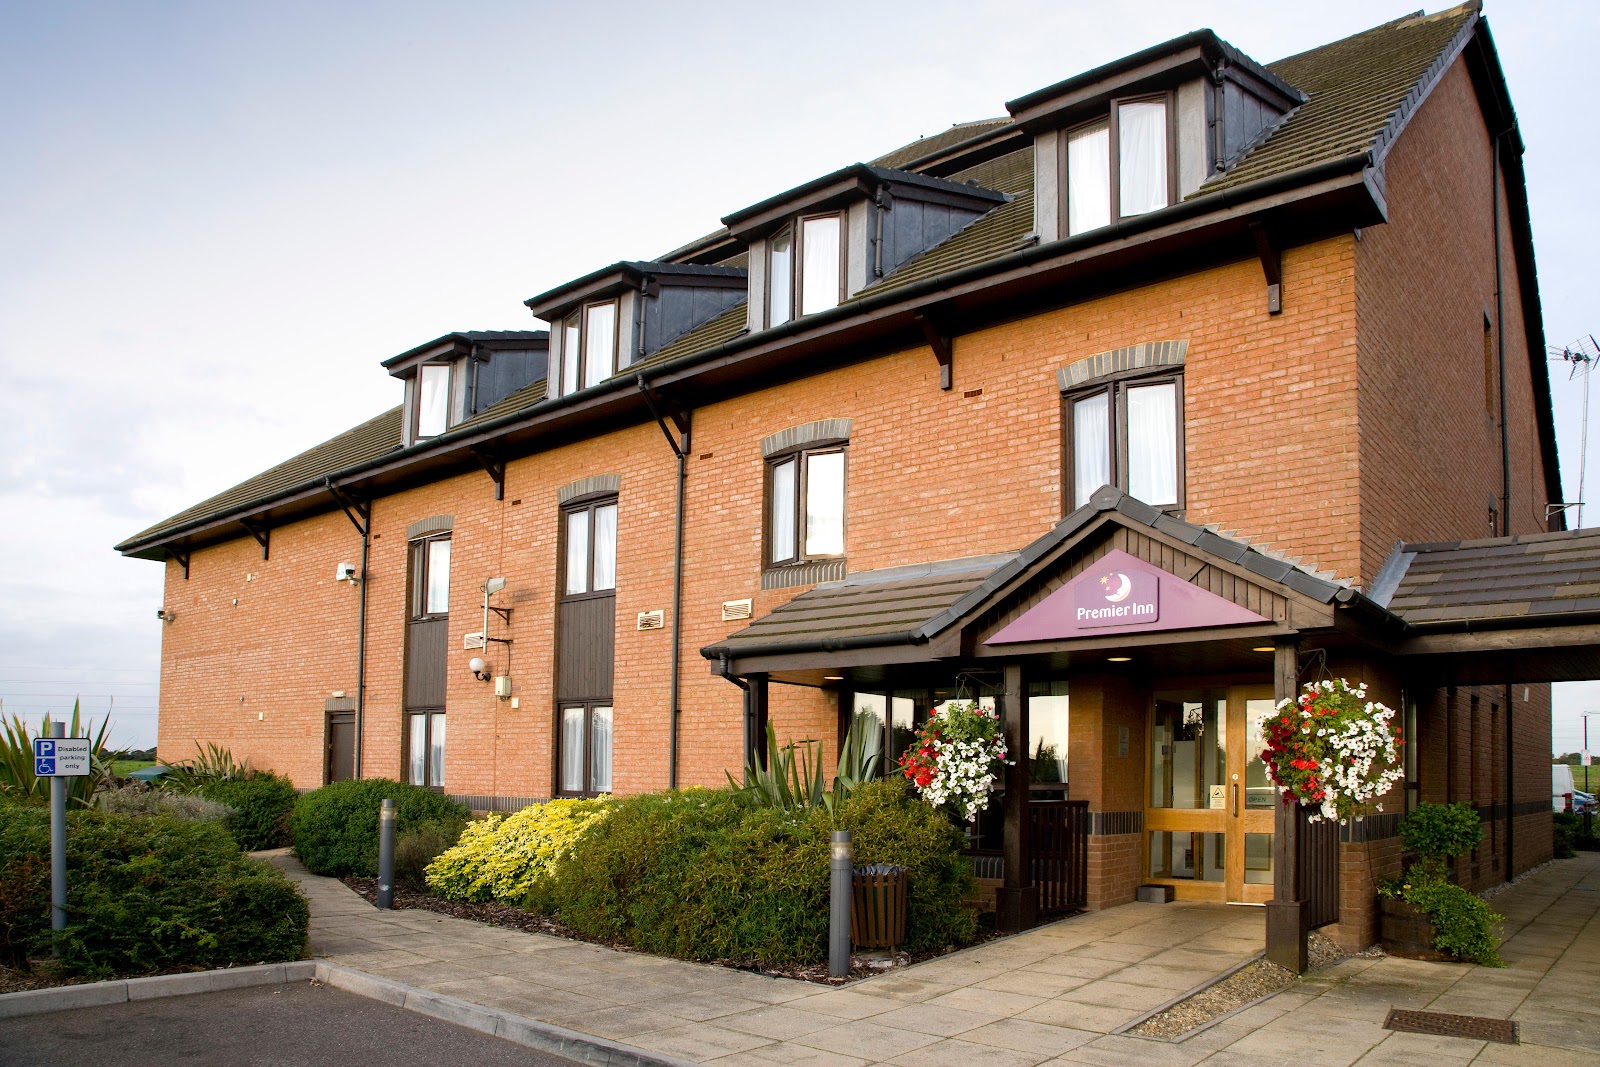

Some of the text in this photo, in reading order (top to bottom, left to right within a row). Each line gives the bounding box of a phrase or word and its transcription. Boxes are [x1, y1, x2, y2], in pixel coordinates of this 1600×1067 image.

[1077, 602, 1154, 620] Premier Inn
[40, 742, 53, 755] P
